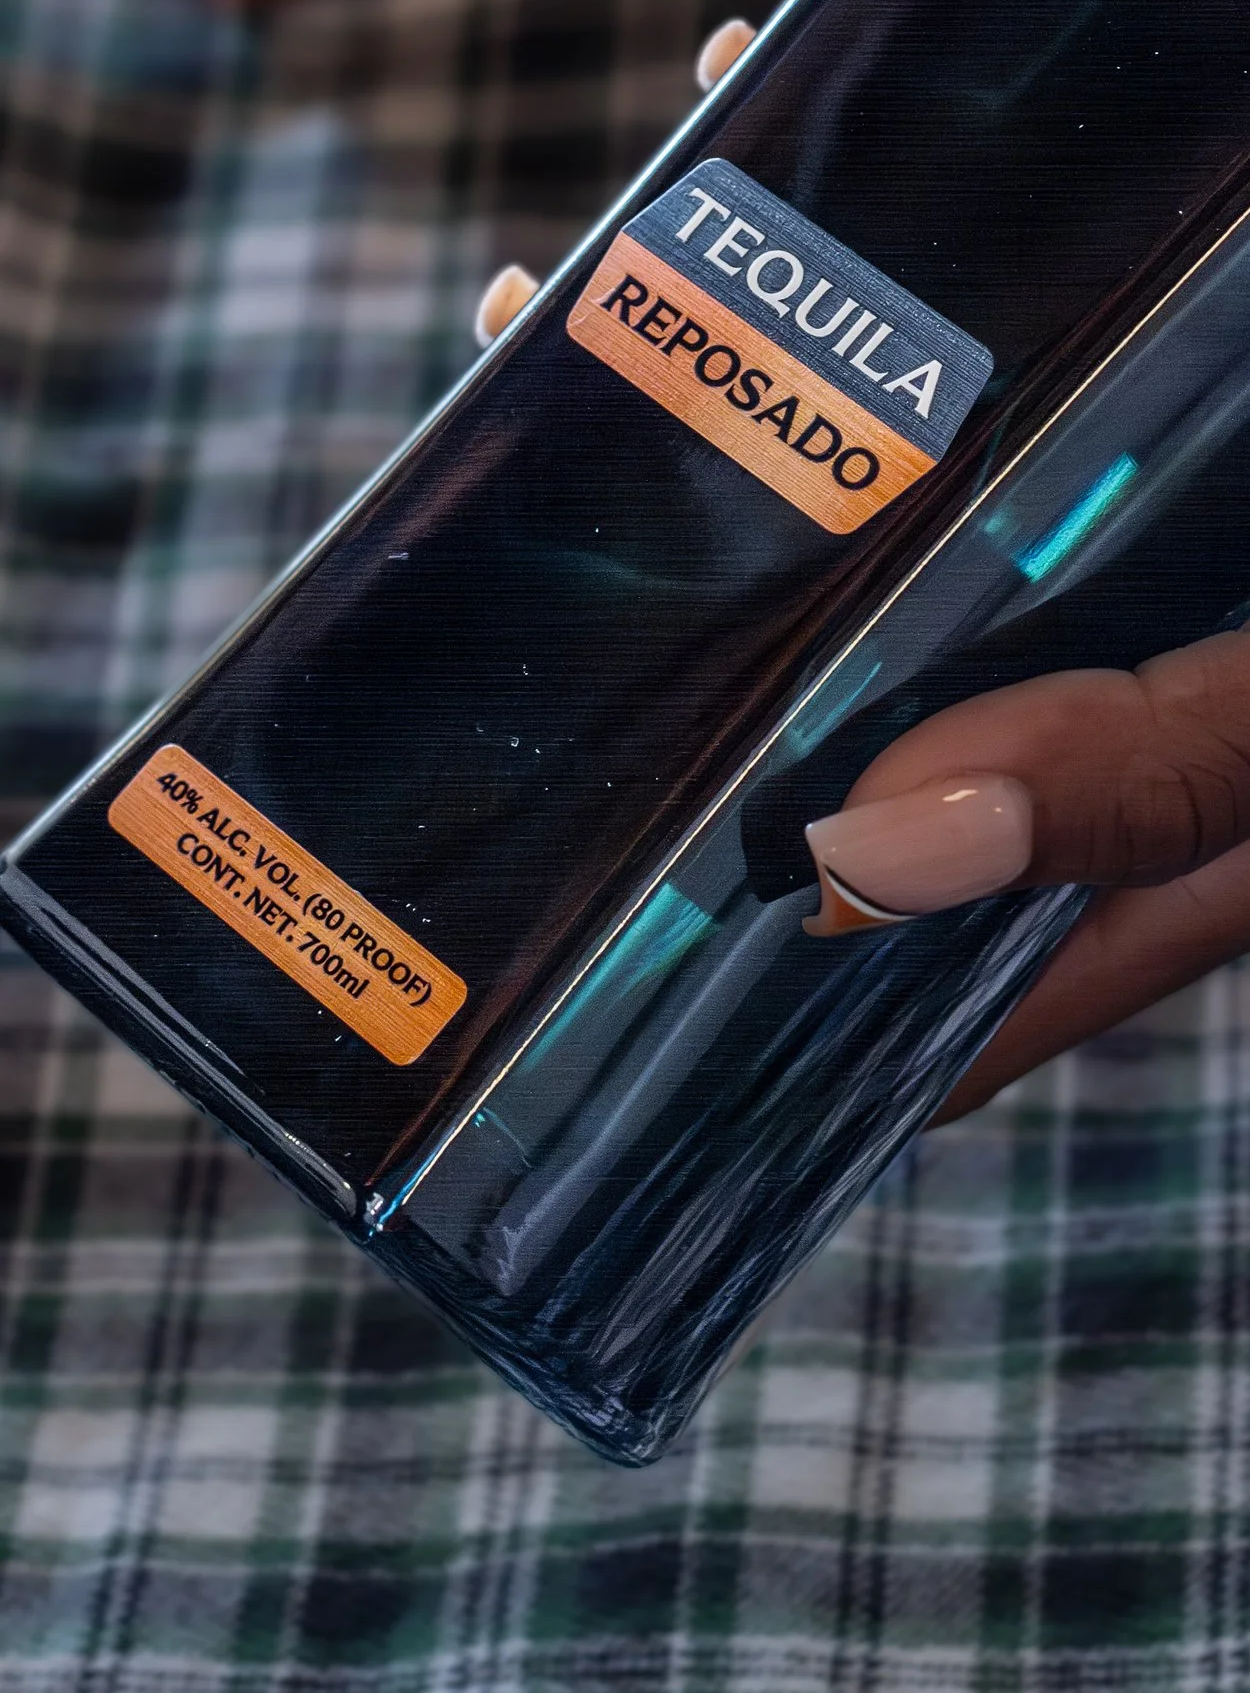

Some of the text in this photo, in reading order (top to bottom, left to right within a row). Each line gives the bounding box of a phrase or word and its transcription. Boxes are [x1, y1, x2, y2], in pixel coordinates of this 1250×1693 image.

[600, 274, 880, 491] REPOSADO
[676, 188, 943, 419] TEQUILA
[157, 773, 432, 1007] 40% ALC. VOL. (80 PROOF)
[176, 832, 370, 1000] CONT. NET. 700ml
